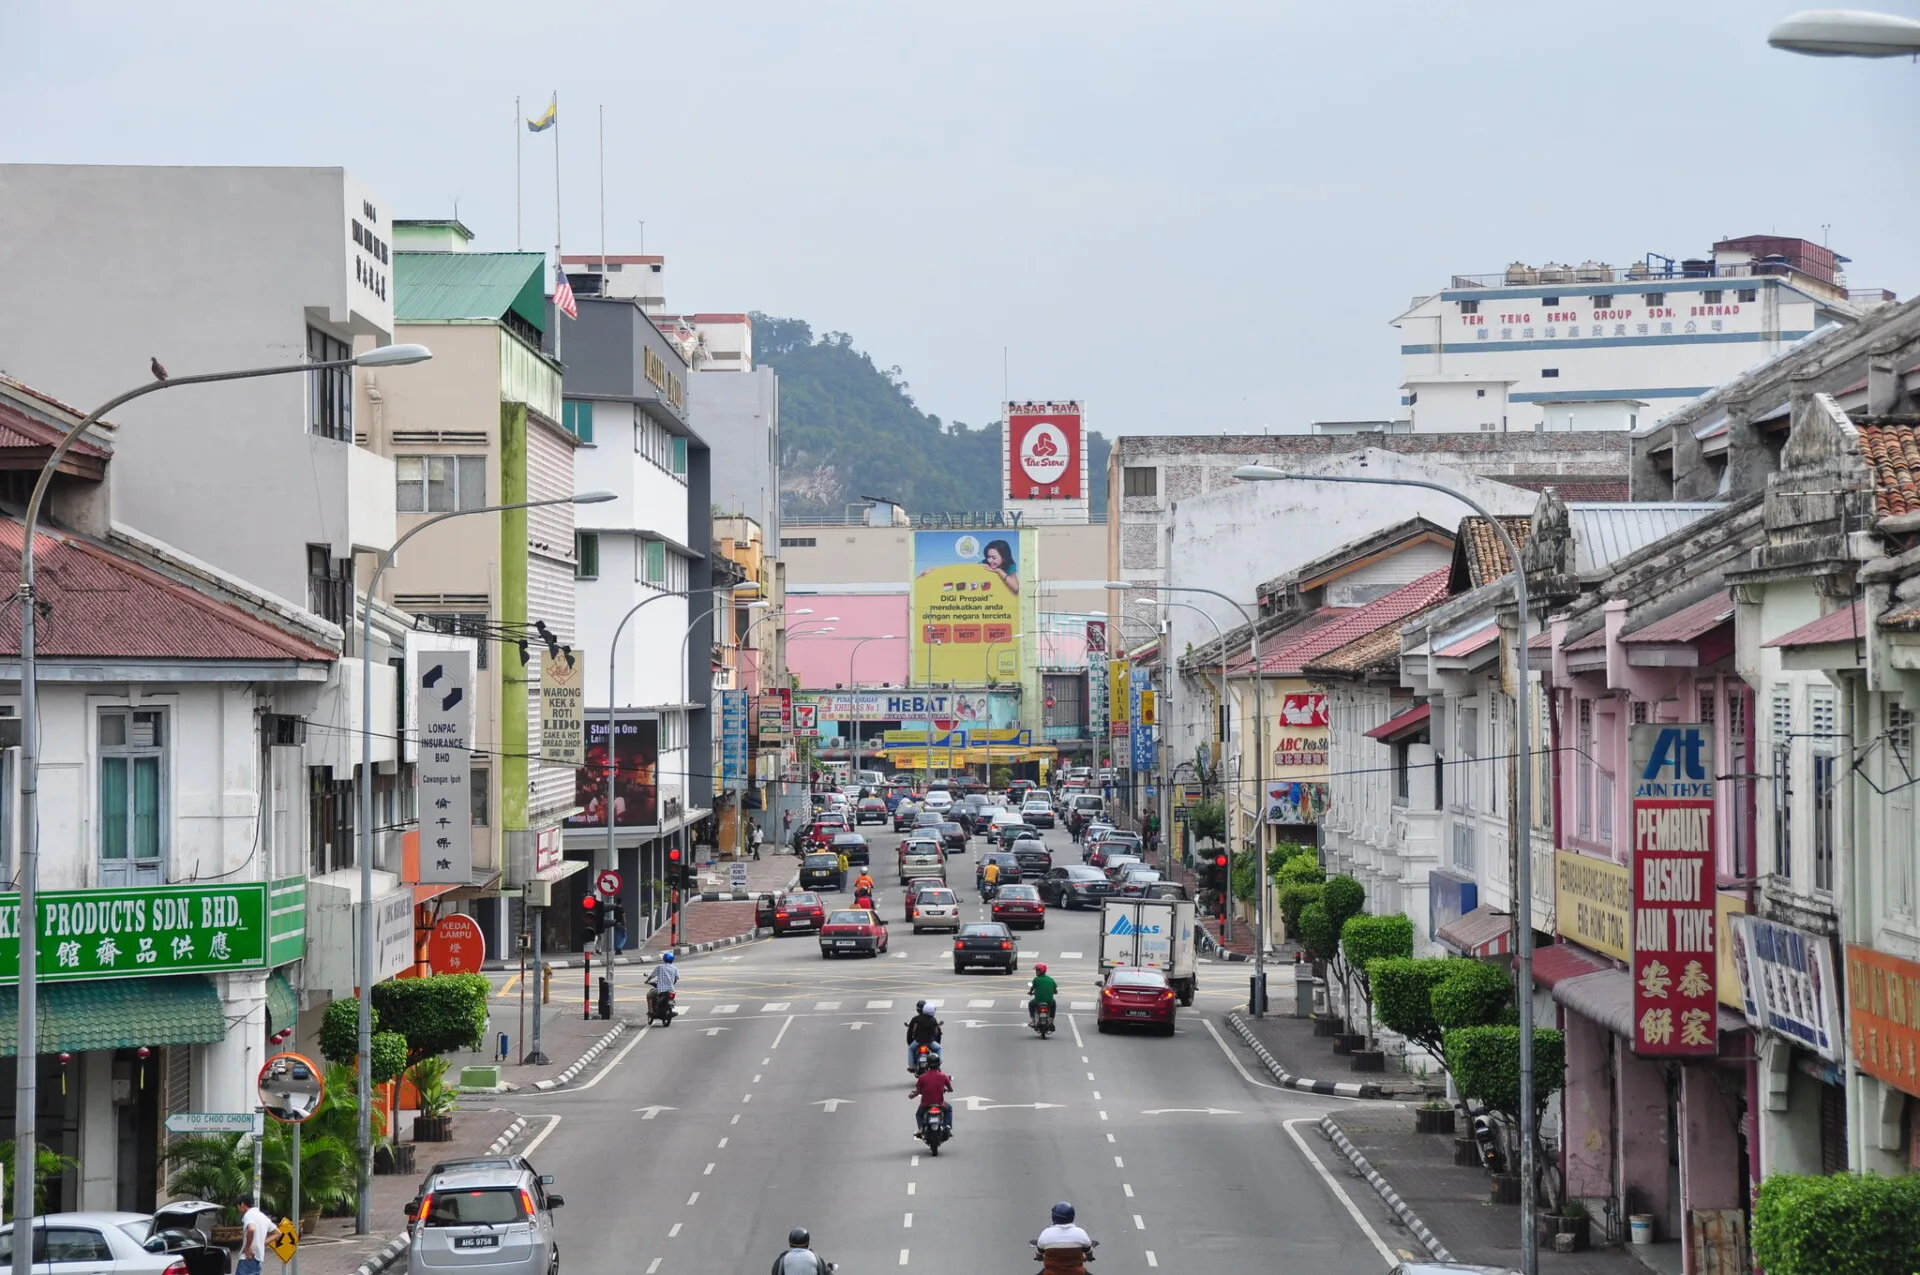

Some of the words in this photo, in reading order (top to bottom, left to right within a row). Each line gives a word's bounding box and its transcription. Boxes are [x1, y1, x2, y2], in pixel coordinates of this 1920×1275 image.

[1462, 315, 1484, 325] TEH
[1500, 313, 1531, 324] TENG
[1547, 311, 1577, 322] SENG
[1593, 309, 1632, 320] GROUP
[1648, 307, 1676, 318] SDN.
[1690, 305, 1740, 317] BERHAD
[1009, 405, 1046, 414] PASAR
[1052, 404, 1080, 413] RAYA
[1024, 457, 1040, 466] The
[1040, 457, 1065, 467] Store
[920, 511, 1023, 528] CATHAY
[940, 594, 957, 602] DiGi
[929, 603, 982, 611] mendekatkan
[984, 603, 1004, 611] anda
[922, 612, 950, 621] dengan
[952, 613, 980, 621] negara
[982, 612, 1012, 620] tercinta
[543, 687, 581, 698] WARONG
[549, 697, 567, 708] KEK
[569, 698, 576, 708] &
[552, 708, 573, 718] ROTI
[428, 723, 456, 735] LONPAC
[543, 719, 580, 730] LIDO
[591, 723, 620, 734] Statin
[622, 723, 638, 734] One
[543, 731, 561, 739] CAKE
[567, 731, 580, 739] HOT
[421, 737, 463, 749] INSURANCE
[542, 739, 563, 748] BREAD
[564, 739, 581, 747] SHOP
[1277, 737, 1303, 751] ABC
[435, 752, 450, 763] BHD
[422, 775, 448, 785] Cawangan
[450, 774, 461, 785] Ipoh
[1635, 783, 1668, 797] AUN
[1673, 783, 1713, 797] THYE
[1636, 807, 1711, 851] PEMBUAT
[1643, 858, 1703, 902] BISKUT
[45, 899, 146, 937] PRODUCTS
[152, 898, 194, 932] SDN.
[201, 895, 243, 929] BHD.
[441, 922, 470, 930] KEDAI
[1636, 908, 1669, 952] AUN
[1673, 908, 1713, 952] THYE
[439, 931, 472, 939] LAMPU
[16, 931, 232, 968] 館齋品供應
[1638, 960, 1713, 999] 安泰
[187, 1115, 201, 1123] FOO
[204, 1115, 223, 1123] CHOO
[226, 1115, 252, 1123] CHOON
[462, 1238, 475, 1246] AHG
[475, 1237, 493, 1246] 9758
